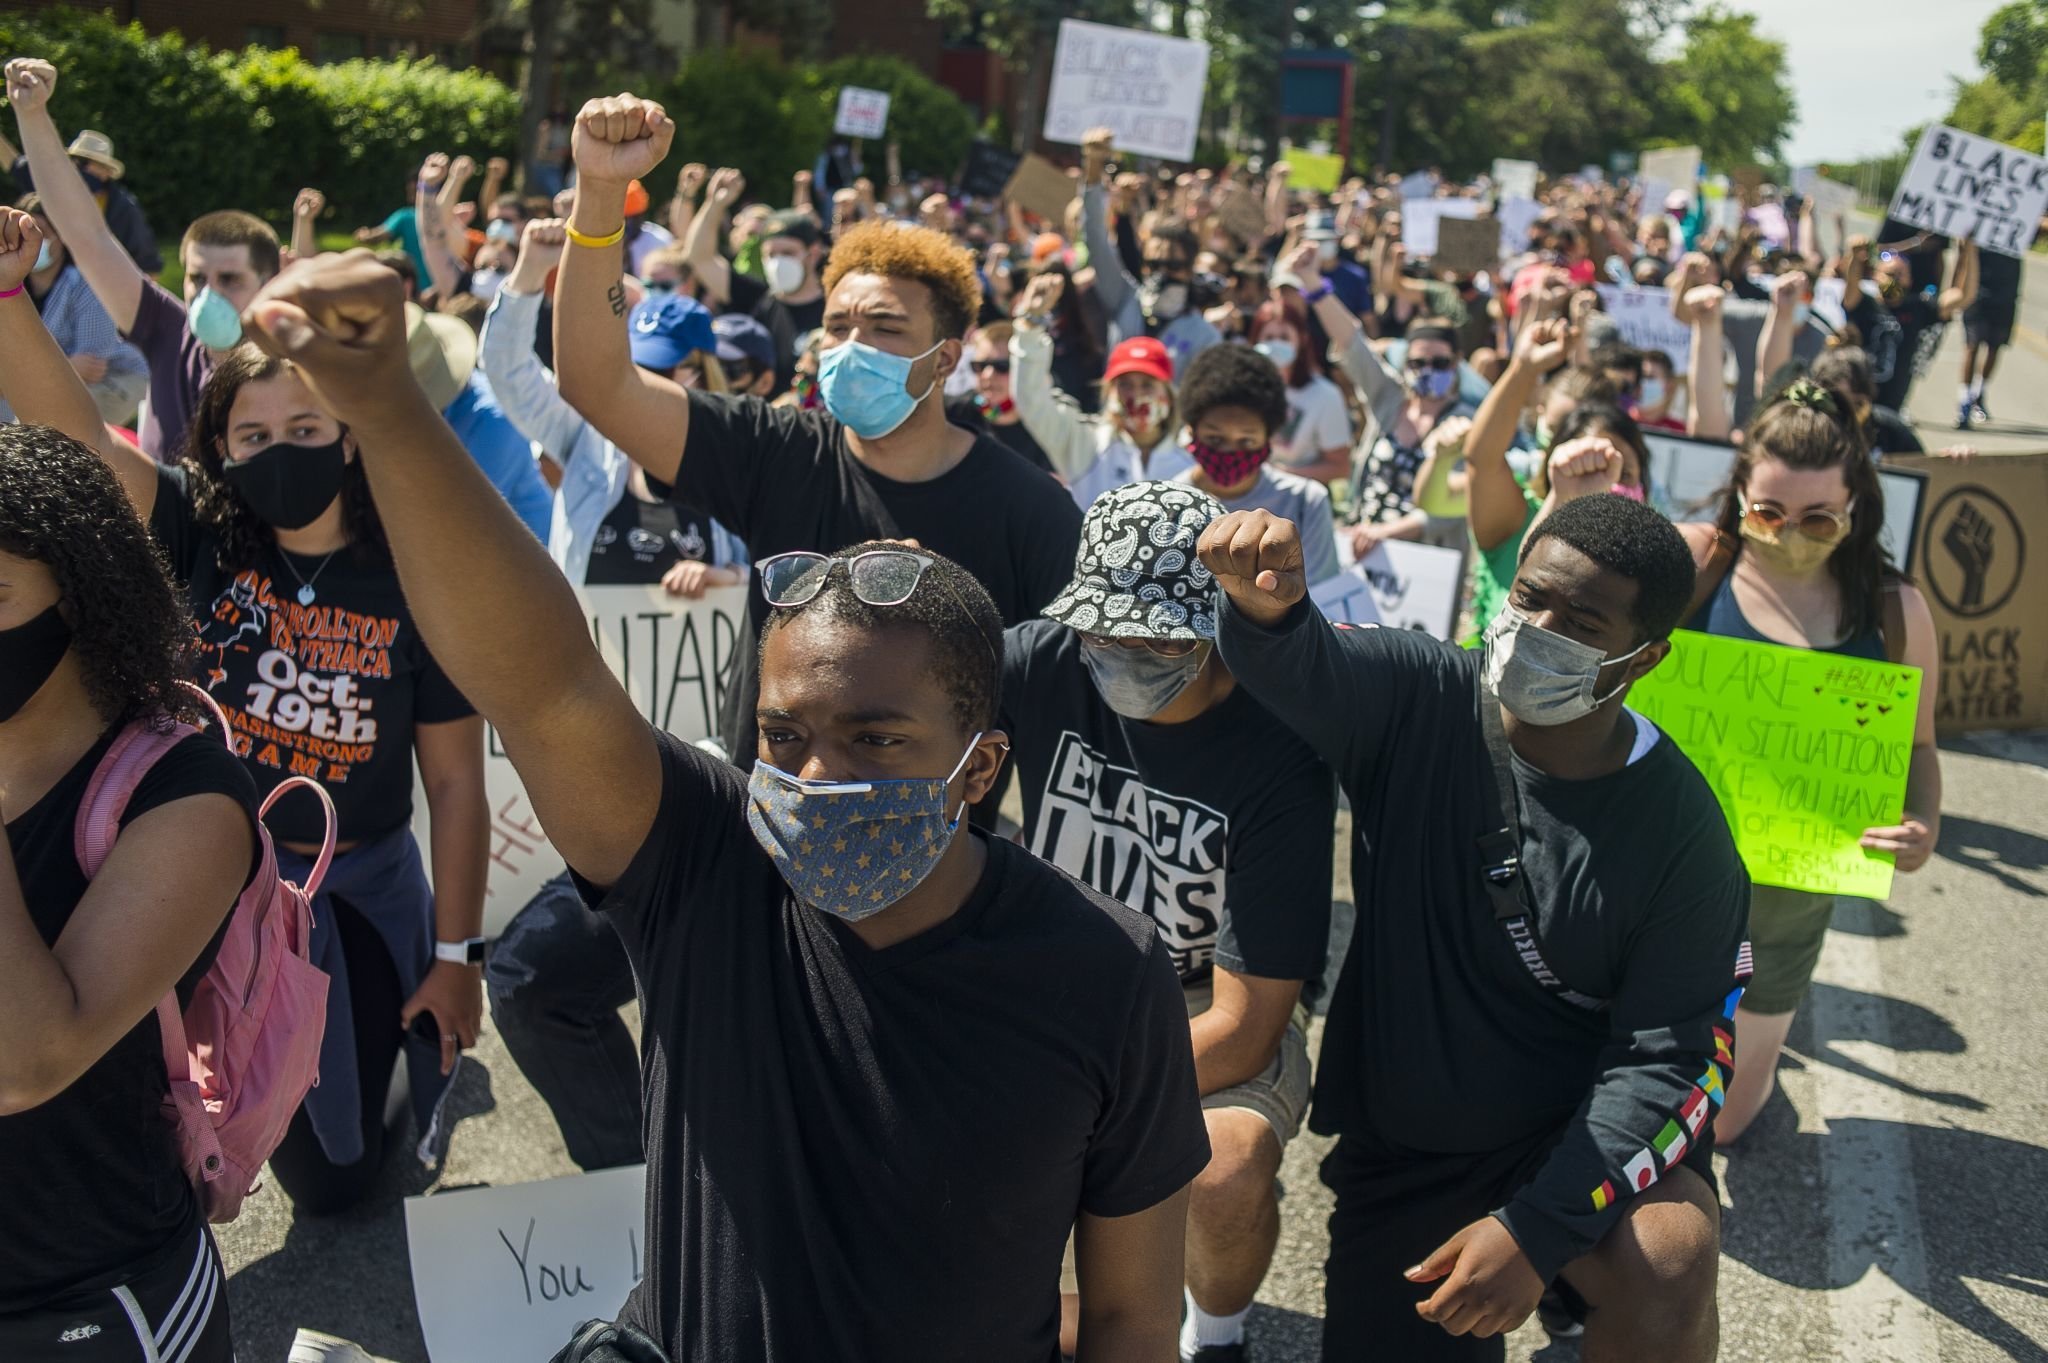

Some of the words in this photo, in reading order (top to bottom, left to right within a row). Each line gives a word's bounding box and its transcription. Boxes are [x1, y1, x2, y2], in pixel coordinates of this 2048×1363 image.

[1932, 132, 2048, 192] BLACK
[1935, 167, 2022, 214] LIVES
[1942, 625, 2022, 665] LACK
[257, 650, 373, 711] Oct.
[1654, 643, 1708, 693] OU
[1718, 650, 1809, 712] ARE
[1824, 666, 1897, 693] #BLM
[1941, 665, 2019, 697] IVES
[246, 683, 377, 743] 19th
[1940, 691, 2024, 719] ATTER
[233, 731, 351, 783] GAME
[1679, 703, 1730, 746] IN
[1739, 716, 1909, 780] SITUATIONS
[1056, 741, 1221, 871] BLACK
[1771, 770, 1822, 813] YOU
[1831, 783, 1899, 824] HAVE
[1742, 811, 1780, 838] OF
[1790, 816, 1848, 850] THE
[498, 1216, 595, 1306] You
